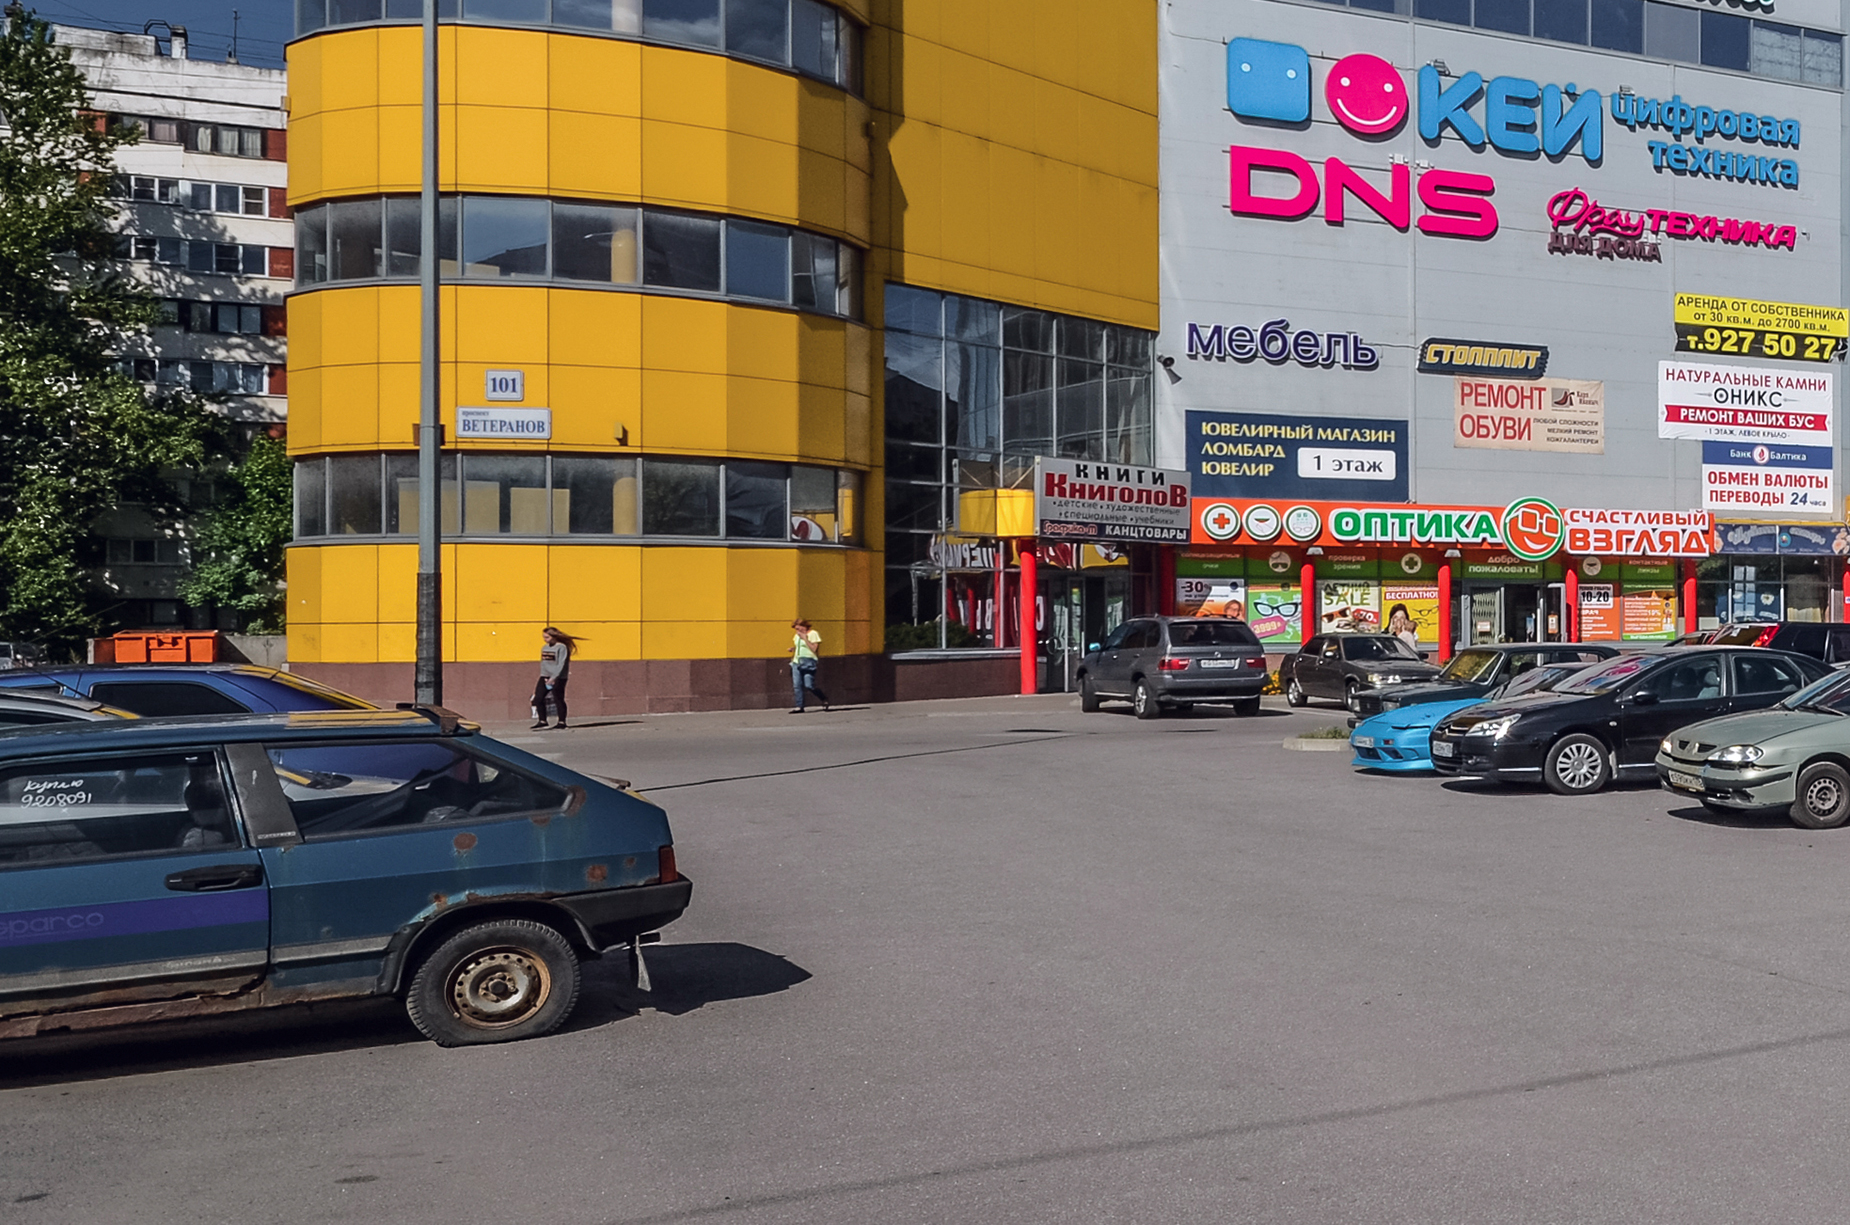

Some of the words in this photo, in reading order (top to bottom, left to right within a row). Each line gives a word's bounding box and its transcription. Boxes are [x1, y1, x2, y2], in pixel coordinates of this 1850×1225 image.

[1611, 92, 1799, 145] цифровая
[1648, 139, 1798, 187] техника
[1229, 145, 1497, 238] DNS
[1678, 296, 1727, 311] АРЕНДА
[1731, 301, 1747, 312] ОТ
[1751, 302, 1845, 321] СОБСТВЕННИКА
[1710, 312, 1722, 322] 30
[1758, 318, 1772, 327] до
[1775, 318, 1800, 329] 2700
[1763, 334, 1796, 356] 50
[1804, 337, 1836, 359] 27
[491, 377, 517, 393] 101
[1666, 368, 1771, 388] НАТУРАЛЬНЫЕ
[1776, 376, 1826, 391] КАМНИ
[1461, 382, 1546, 410] РЕМОНТ
[1714, 388, 1782, 407] ОНИКС
[462, 419, 545, 433] ВЕТЕРАНОВ
[1680, 408, 1734, 424] РЕМОНТ
[1738, 412, 1785, 427] ВАШИХ
[1789, 416, 1814, 428] БУС
[1202, 421, 1312, 440] ЮВЕЛИРНЫЙ
[1317, 427, 1395, 442] МАГАЗИН
[1460, 414, 1531, 441] ОБУВИ
[1201, 442, 1285, 458] ЛОМБАРД
[1730, 449, 1751, 458] Банк
[1770, 451, 1806, 461] Балтика
[1202, 462, 1274, 477] ЮВЕЛИР
[1313, 455, 1322, 471] 1
[1332, 457, 1383, 473] этаж
[1075, 464, 1164, 486] КНИГИ
[1708, 471, 1759, 486] ОБМЕН
[1764, 474, 1828, 489] ВАЛЮТЫ
[1709, 490, 1784, 506] ПЕРЕВОДЫ
[1790, 492, 1808, 506] 24
[1105, 504, 1180, 515] художественные
[1569, 509, 1706, 526] СЧАСТЛИВЫЙ
[1134, 515, 1174, 525] учебники
[1332, 511, 1498, 540] ОПТИКА
[1105, 525, 1186, 540] КАНЦТОВАРЫ
[1569, 528, 1706, 553] ВЗГЛЯД
[1469, 565, 1538, 573] пожаловать!
[1324, 592, 1370, 605] SALE
[1386, 591, 1438, 600] БЕСПЛАТНО!
[1581, 591, 1609, 602] 10-20
